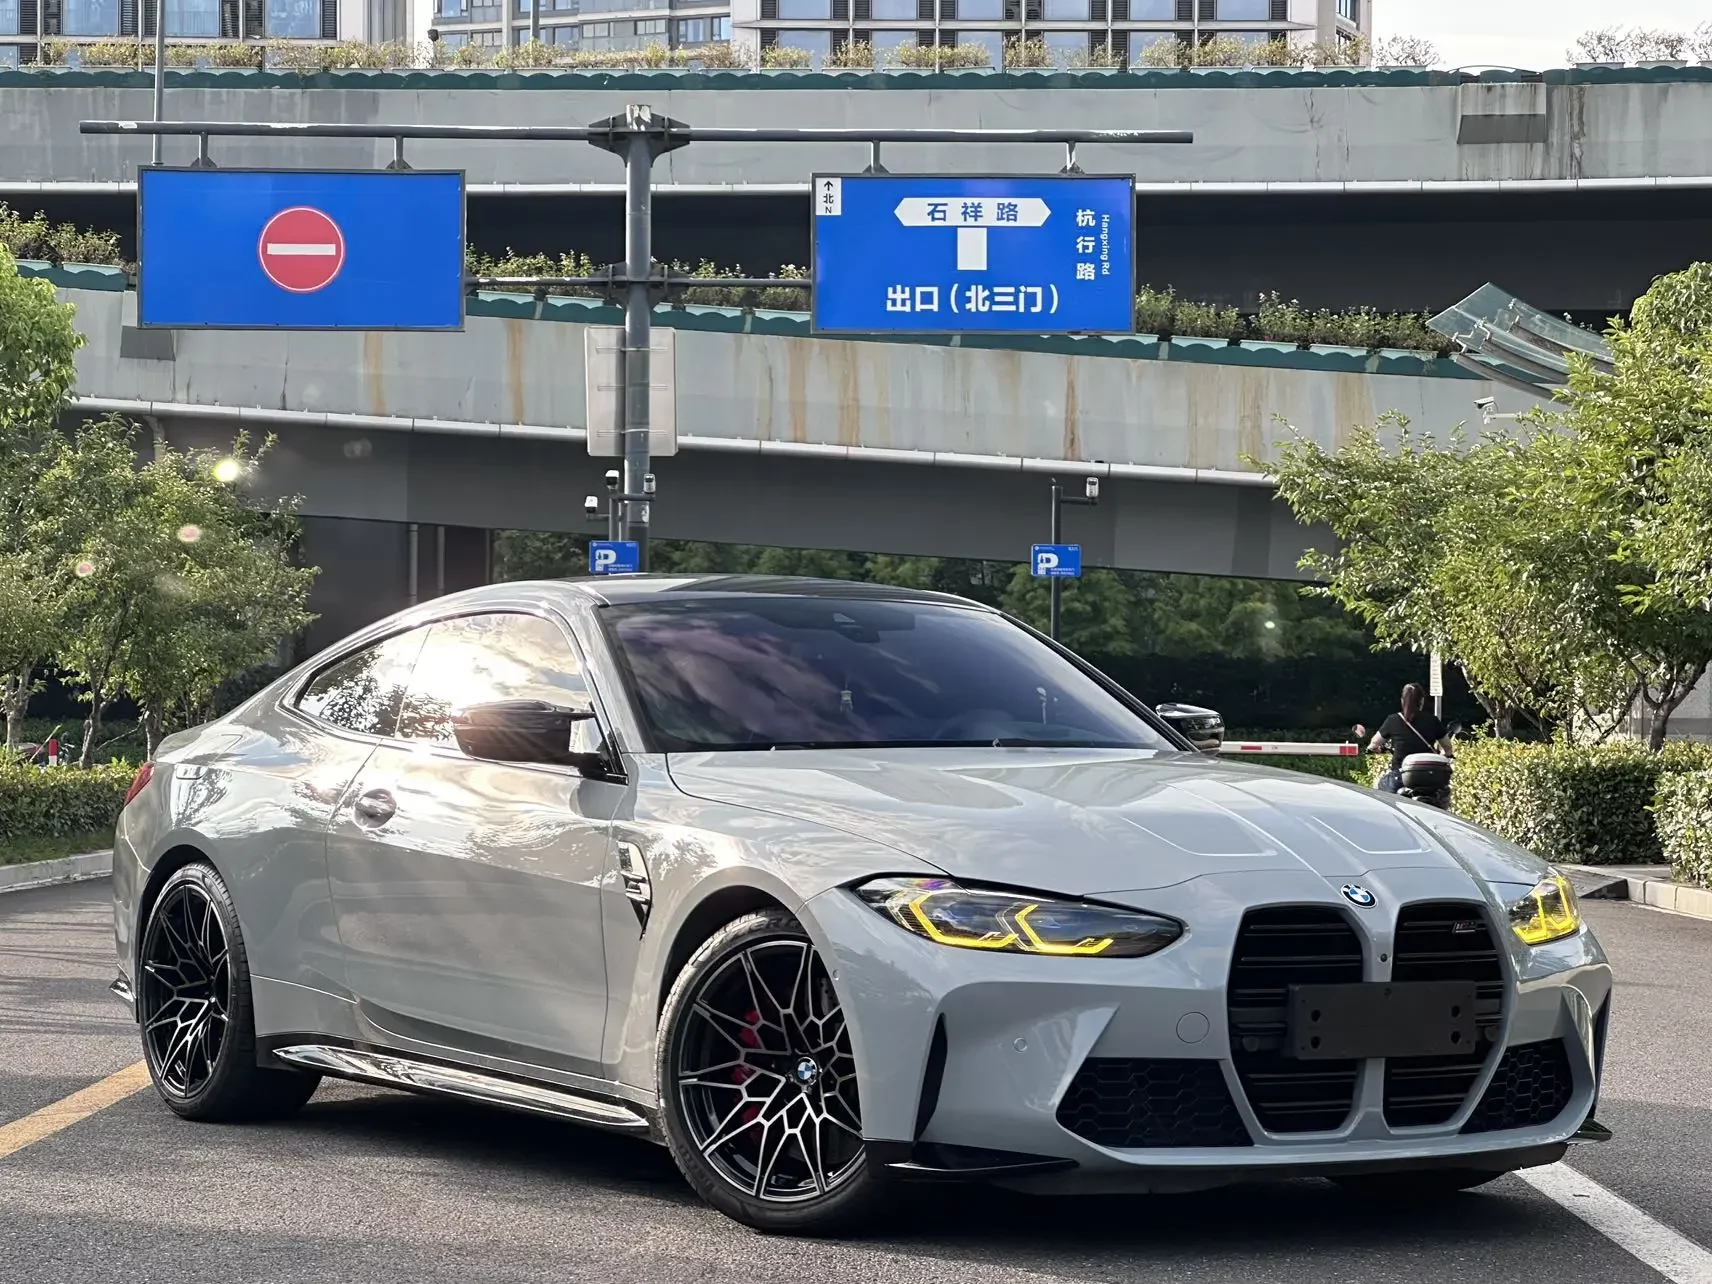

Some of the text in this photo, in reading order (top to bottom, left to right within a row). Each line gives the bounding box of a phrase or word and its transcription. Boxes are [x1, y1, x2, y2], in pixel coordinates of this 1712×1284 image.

[823, 193, 834, 204] 北
[825, 206, 832, 214] N
[927, 202, 1018, 222] 石祥路
[1076, 209, 1096, 280] 杭行路
[1100, 214, 1110, 275] Hangxing Rd
[886, 283, 1058, 314] 出口（北三门）
[595, 549, 617, 571] P
[1037, 553, 1059, 575] P
